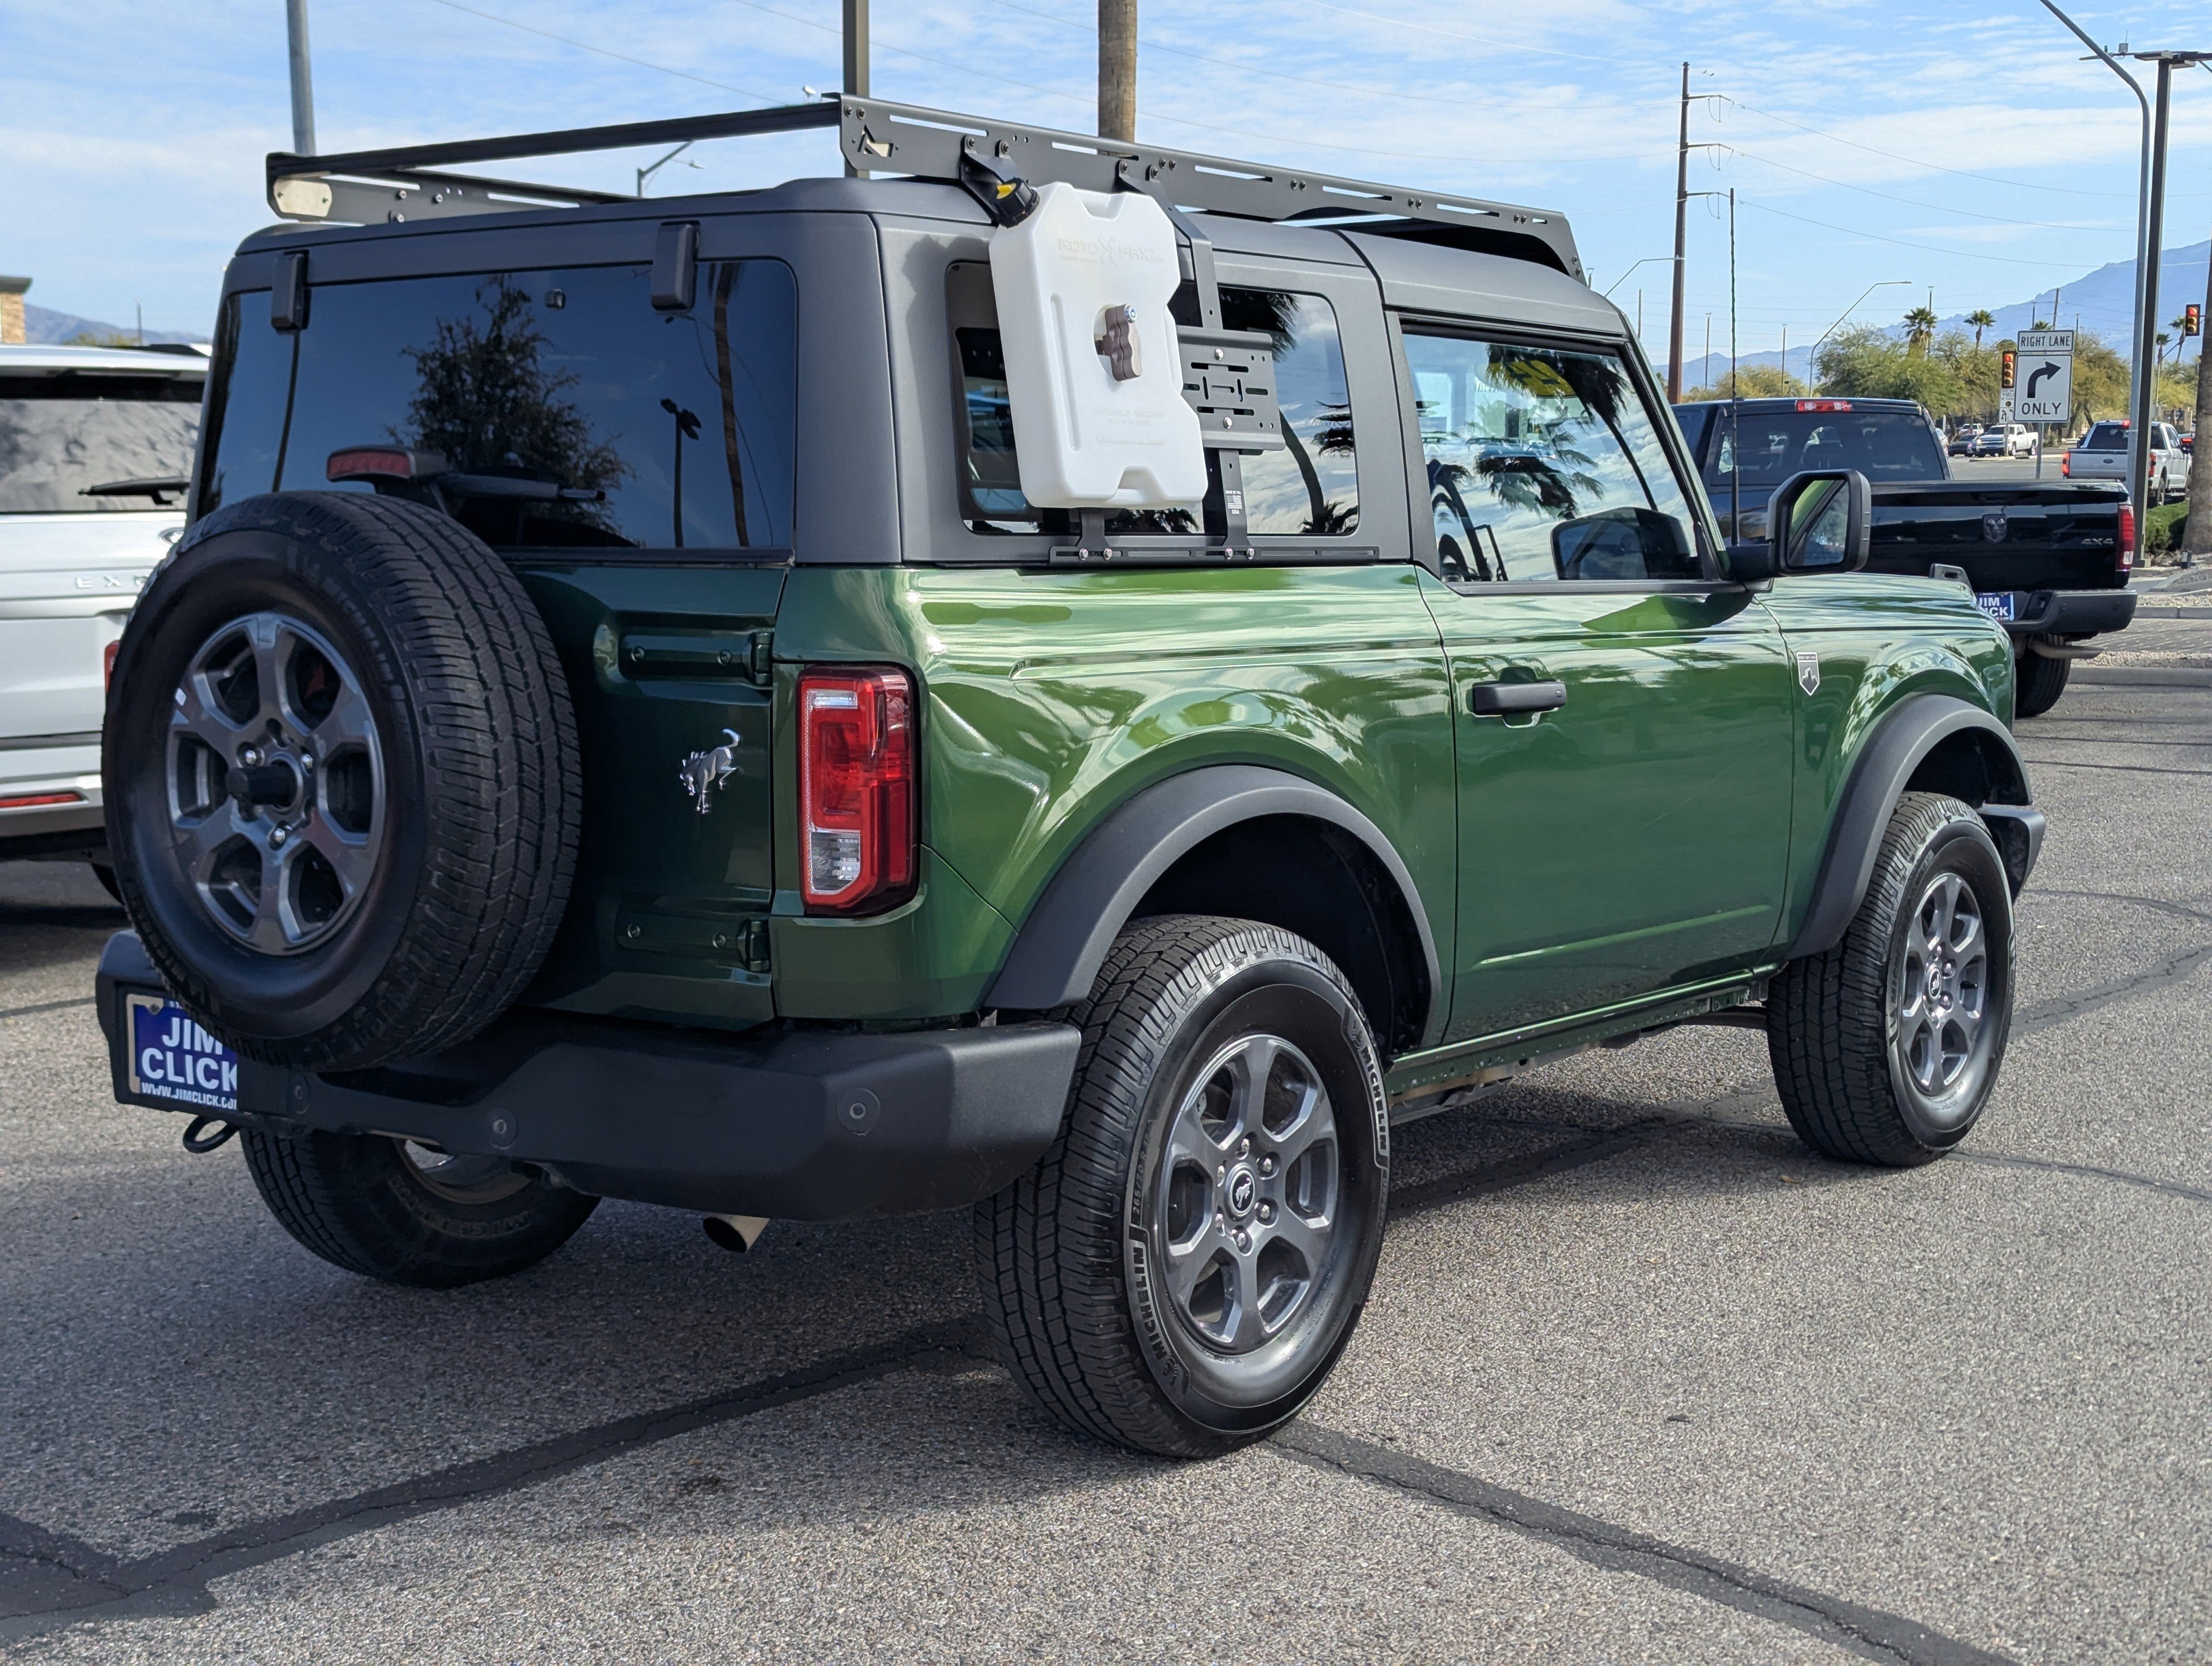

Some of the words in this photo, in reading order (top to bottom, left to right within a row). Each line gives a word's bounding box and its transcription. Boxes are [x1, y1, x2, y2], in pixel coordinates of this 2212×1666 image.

[2021, 336, 2044, 347] RIGHT
[2049, 336, 2070, 347] LANE
[2021, 402, 2061, 415] ONLY
[1979, 597, 2000, 607] JIM
[162, 1017, 223, 1055] JIM
[141, 1047, 237, 1092] CLICK
[141, 1082, 237, 1110] WWW.JIMCLICK.CO
[1361, 1045, 1387, 1150] MICHELIN
[1133, 1246, 1167, 1361] MICHELIN
